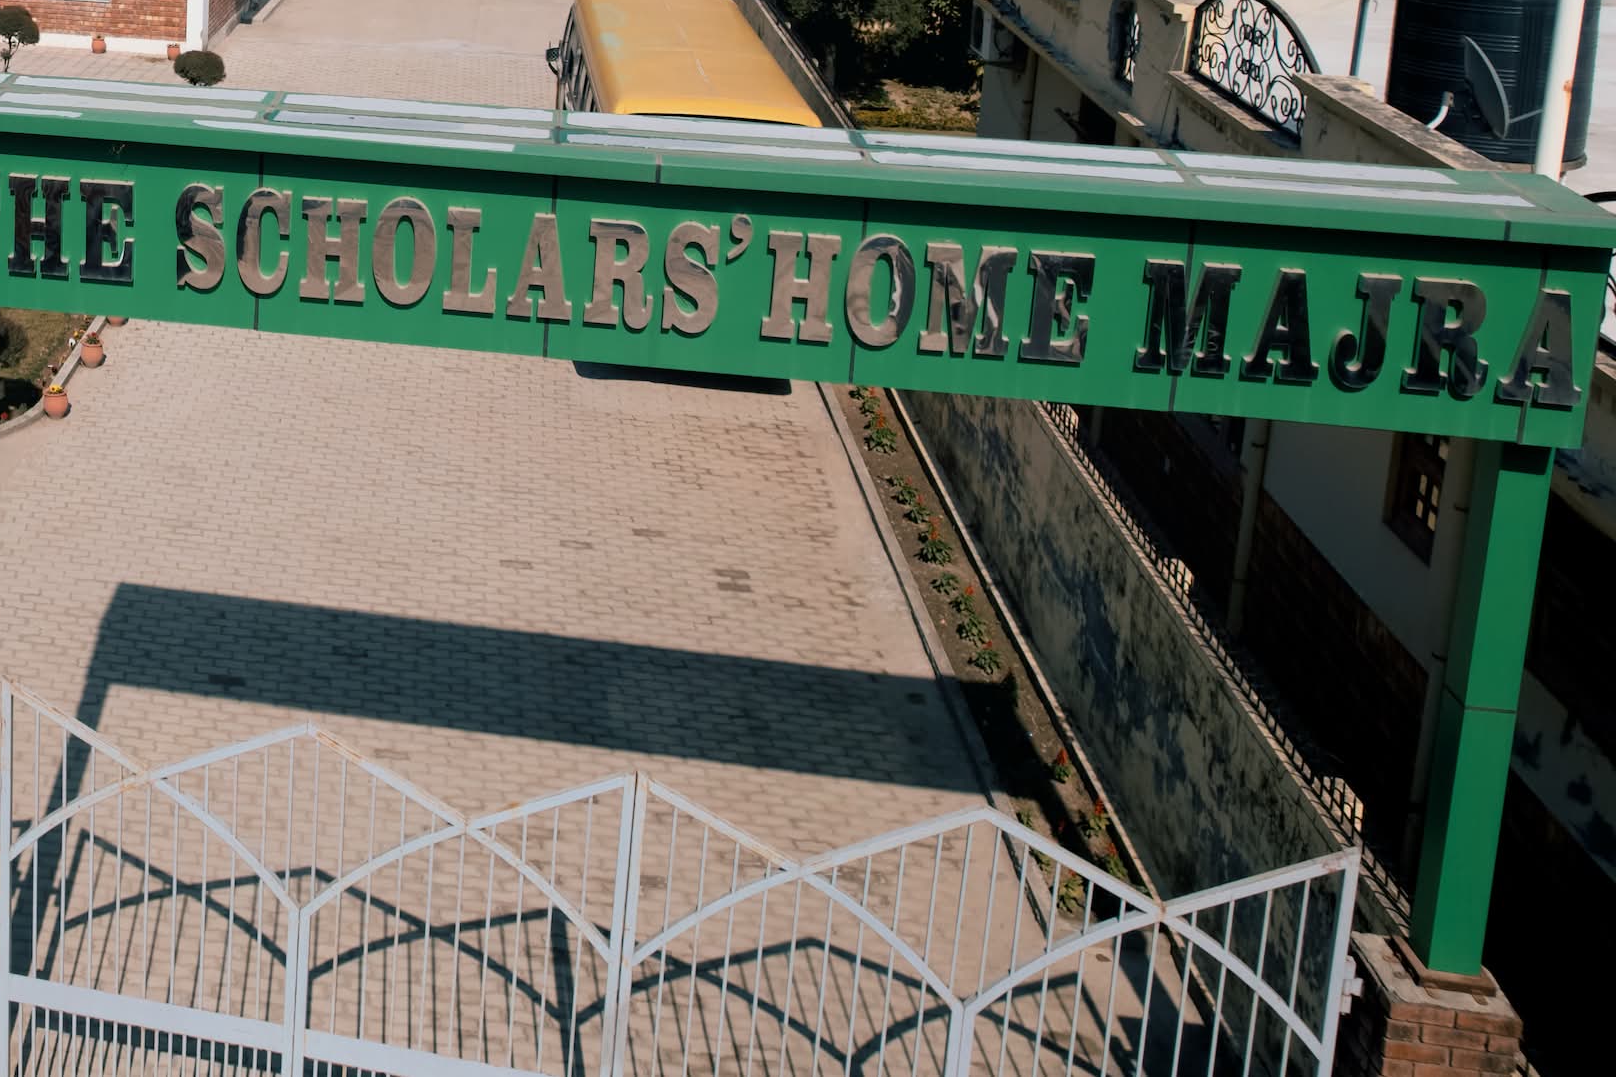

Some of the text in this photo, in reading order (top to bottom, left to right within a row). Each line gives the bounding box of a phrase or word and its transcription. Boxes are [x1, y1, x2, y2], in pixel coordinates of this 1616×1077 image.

[175, 183, 754, 335] SCHOLARS'
[760, 232, 1096, 364] HOME
[1135, 258, 1582, 408] MAJRA
